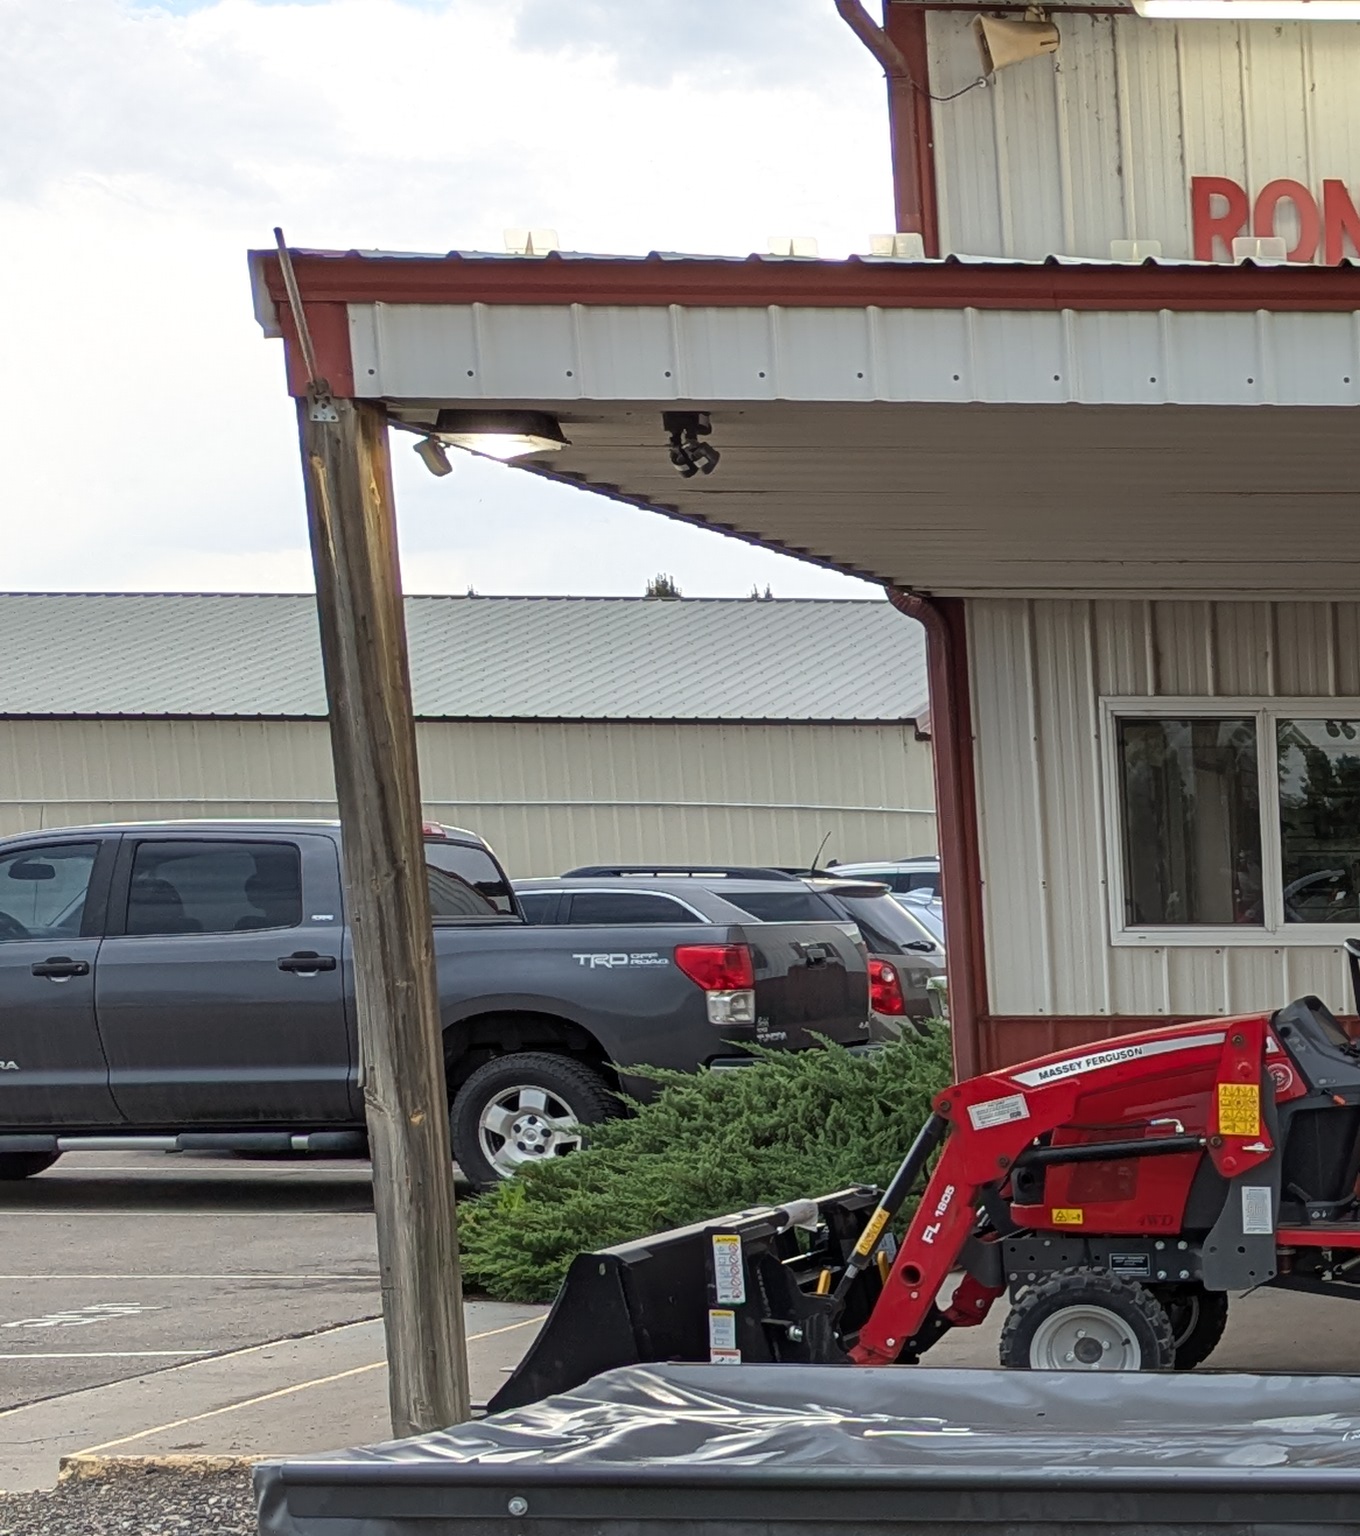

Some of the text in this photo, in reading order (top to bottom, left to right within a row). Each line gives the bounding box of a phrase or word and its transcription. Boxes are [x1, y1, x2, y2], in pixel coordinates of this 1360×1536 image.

[572, 953, 629, 968] TRD
[1038, 1047, 1143, 1080] MASSEY FERGUSON
[921, 1222, 941, 1244] FL
